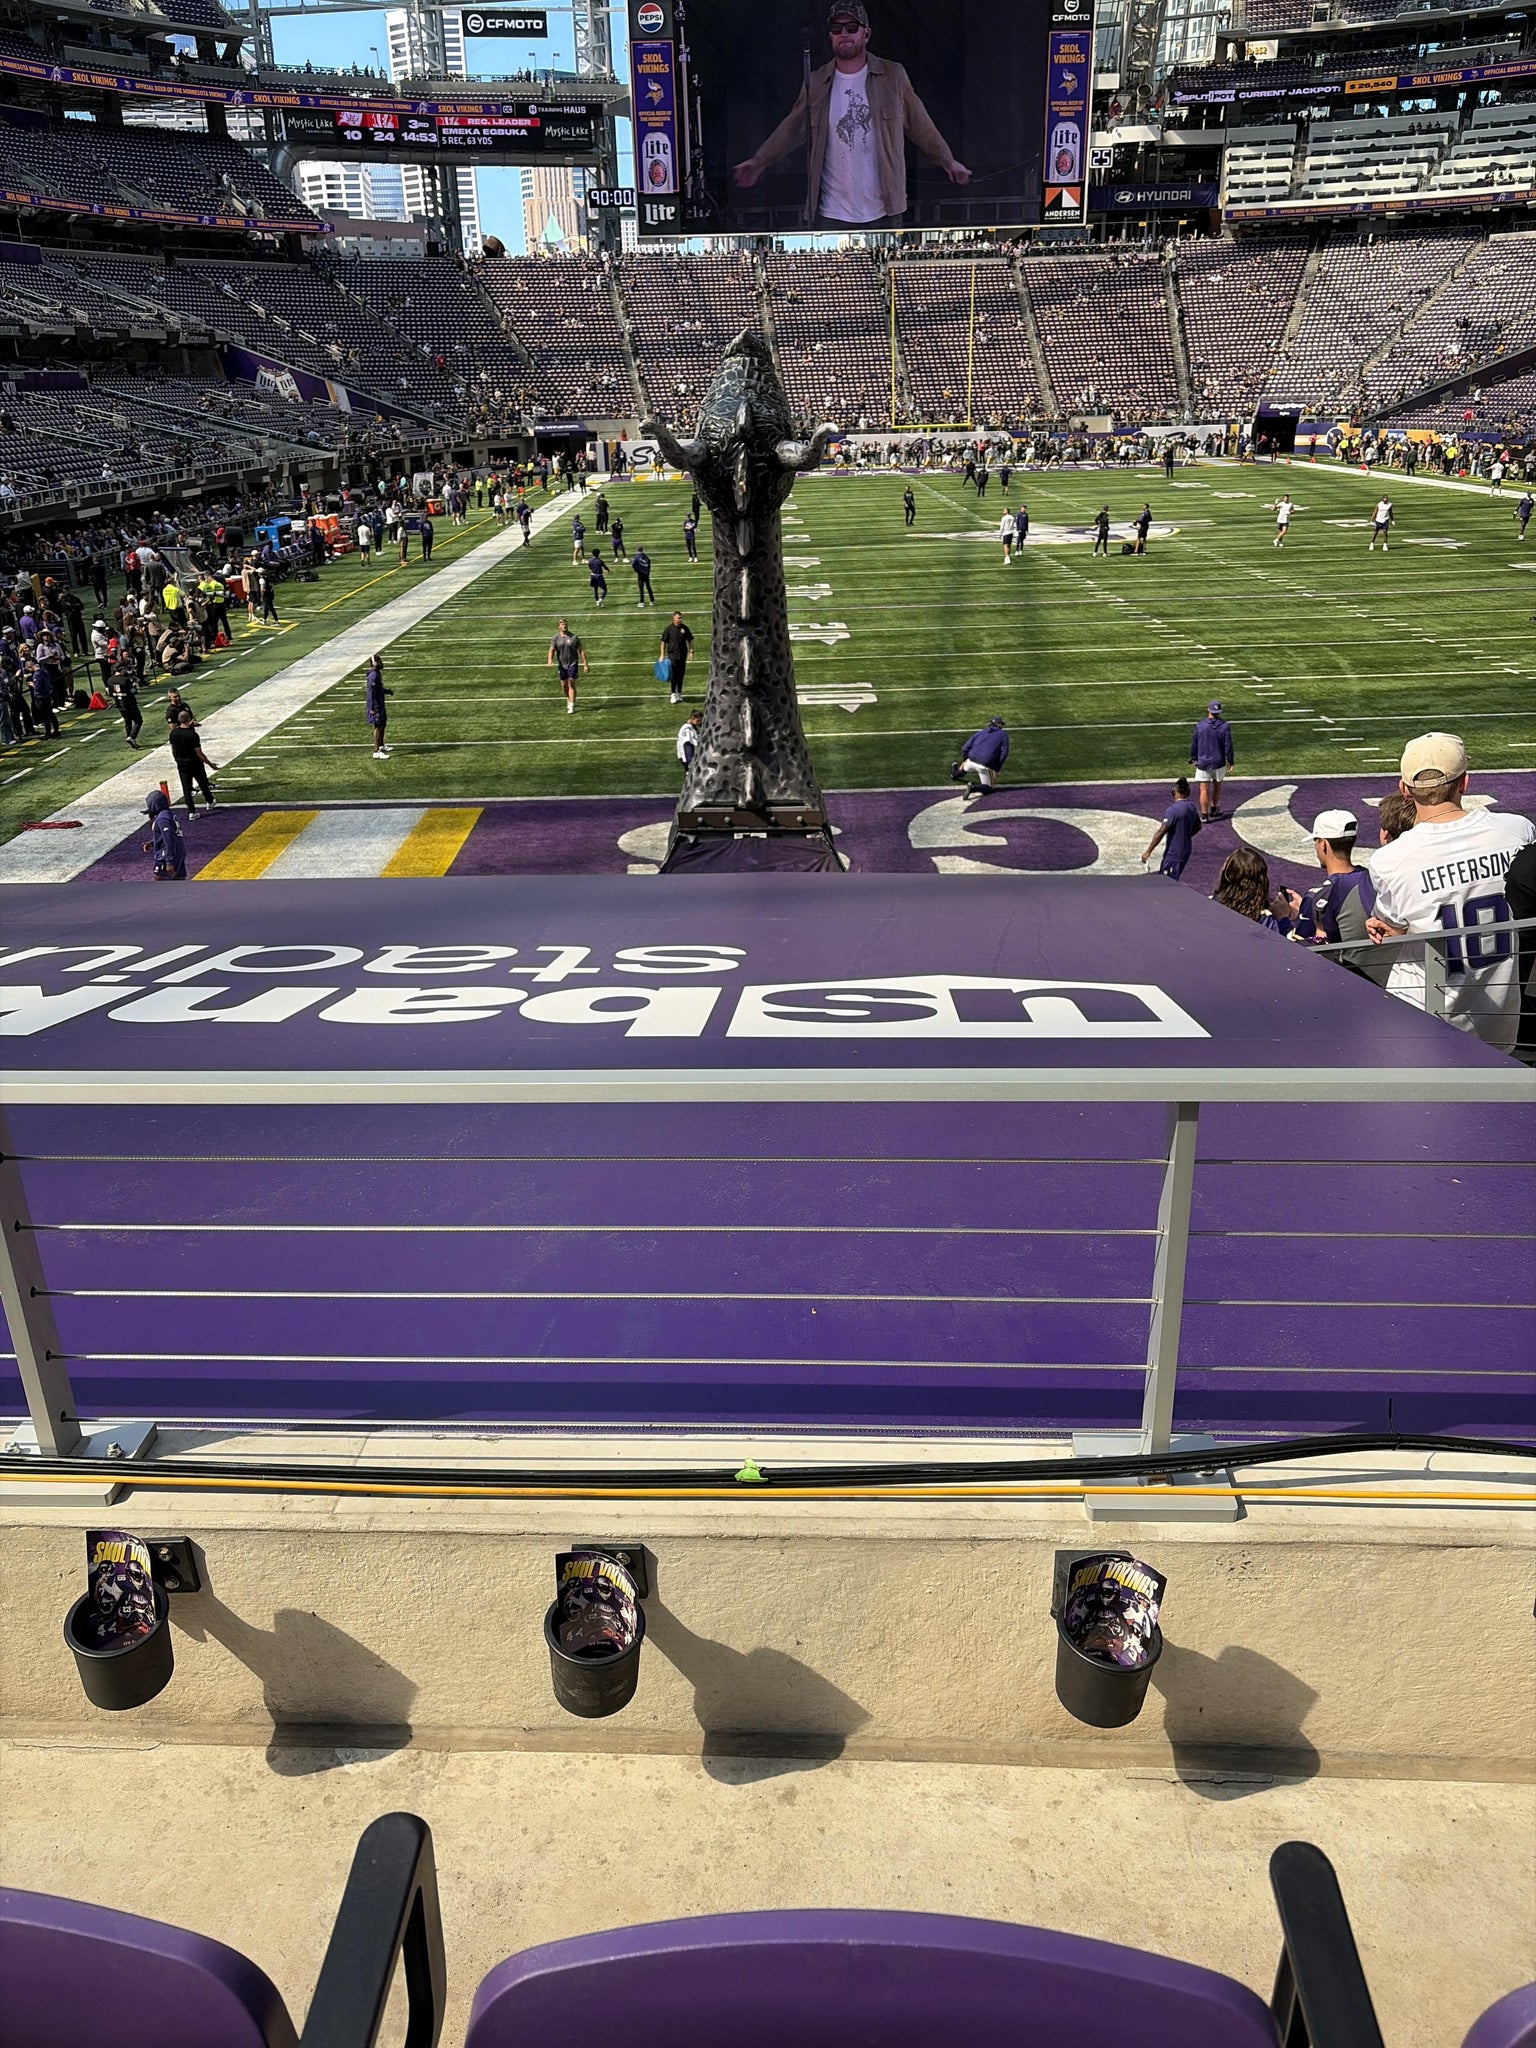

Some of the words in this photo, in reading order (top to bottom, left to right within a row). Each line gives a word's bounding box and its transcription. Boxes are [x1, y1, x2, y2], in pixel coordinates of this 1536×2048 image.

[486, 19, 543, 29] CFMOTO
[1060, 44, 1080, 53] SKOL
[642, 54, 663, 63] SKOL
[1054, 54, 1085, 63] VIKINGS
[637, 64, 669, 74] VIKINGS
[72, 73, 90, 83] SKOL
[91, 76, 118, 87] VIKINGS
[1412, 76, 1431, 85] SKOL
[1433, 72, 1462, 83] VIKINGS
[254, 94, 272, 102] SKOL
[272, 95, 300, 104] VIKINGS
[1239, 90, 1286, 99] CURRENT
[564, 106, 586, 114] HAUS
[344, 130, 362, 140] 10
[374, 132, 395, 142] 24
[402, 132, 437, 142] 14:53
[1054, 130, 1077, 148] Lite
[448, 137, 466, 146] REC,
[646, 140, 669, 158] Lite
[1093, 150, 1109, 165] 25
[591, 190, 632, 206] 90:00
[1137, 190, 1191, 201] HYUNDAI
[644, 204, 676, 225] Lite
[1421, 851, 1510, 894] JEFFERSON
[0, 946, 746, 982] stadiu
[1105, 1561, 1159, 1599] VIKINGS
